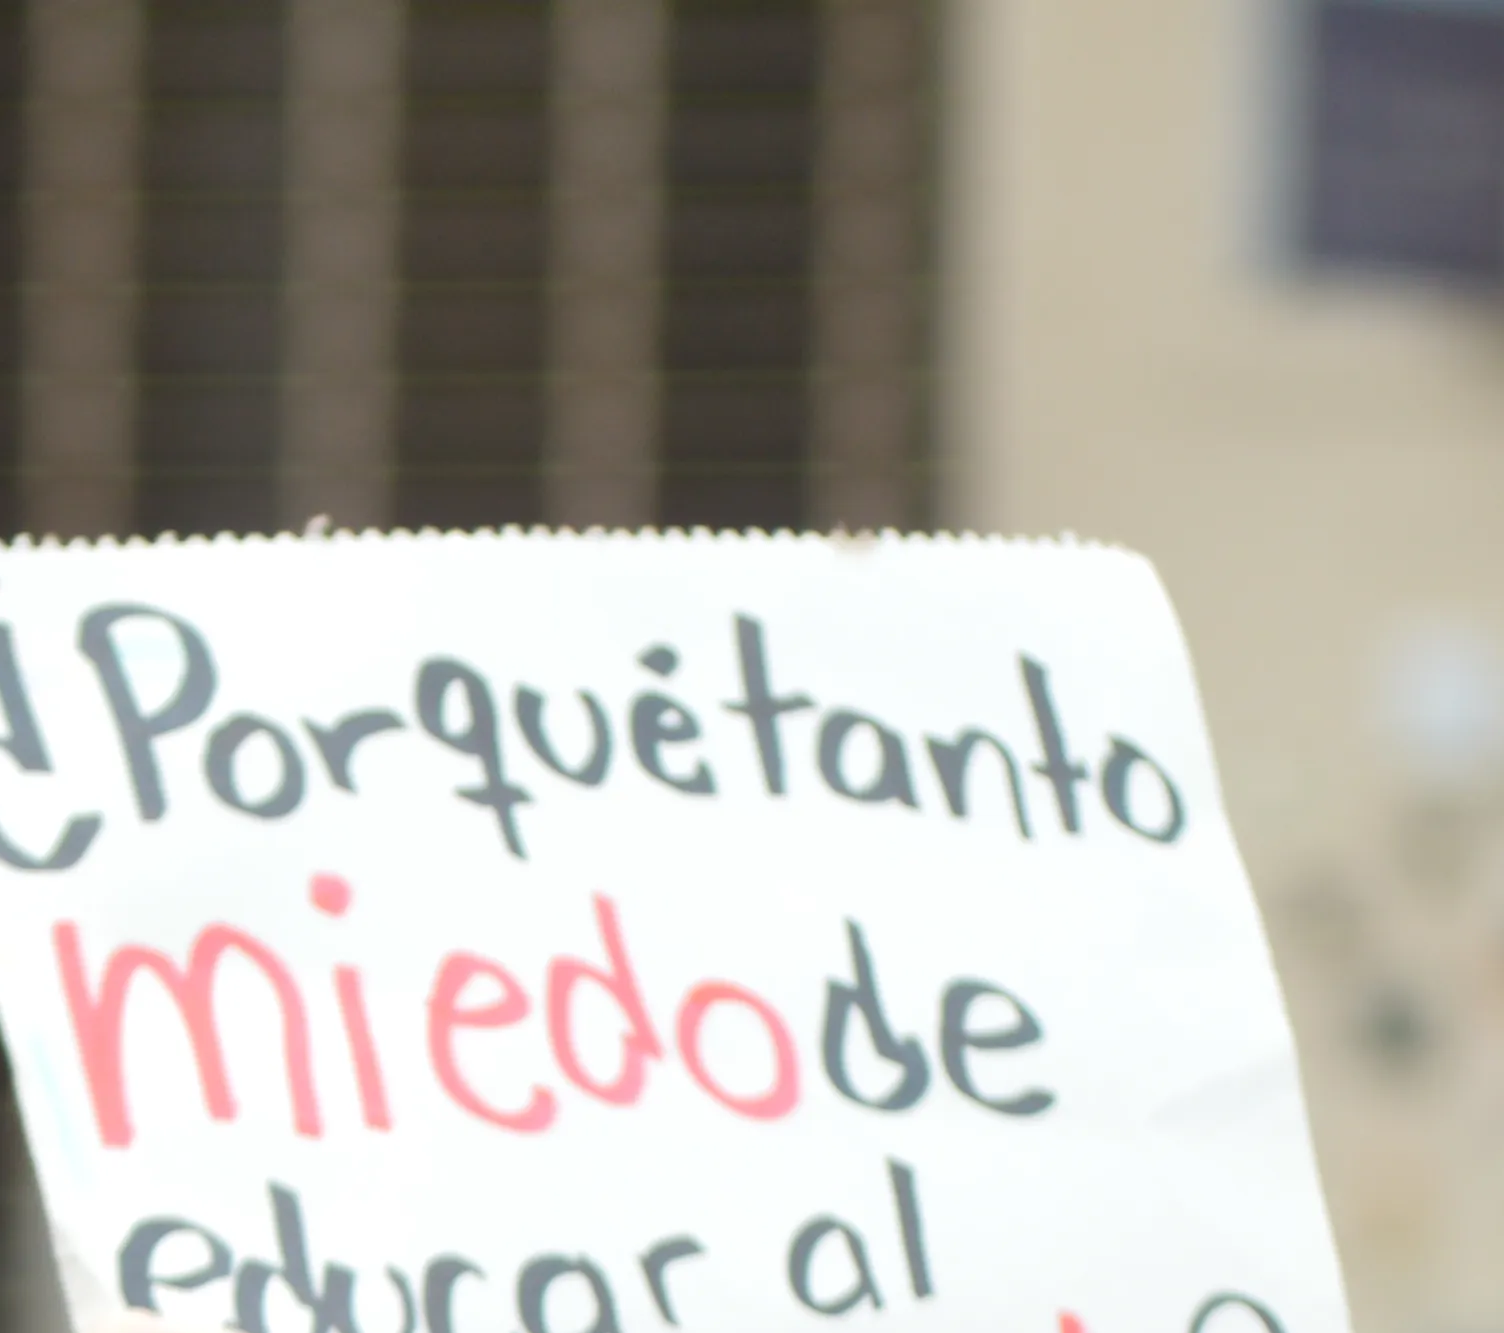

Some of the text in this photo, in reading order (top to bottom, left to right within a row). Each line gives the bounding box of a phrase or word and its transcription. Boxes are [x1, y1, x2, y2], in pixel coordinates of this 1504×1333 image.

[724, 604, 1188, 846] tanto
[50, 870, 1058, 1150] miedo de
[784, 1157, 935, 1319] al
